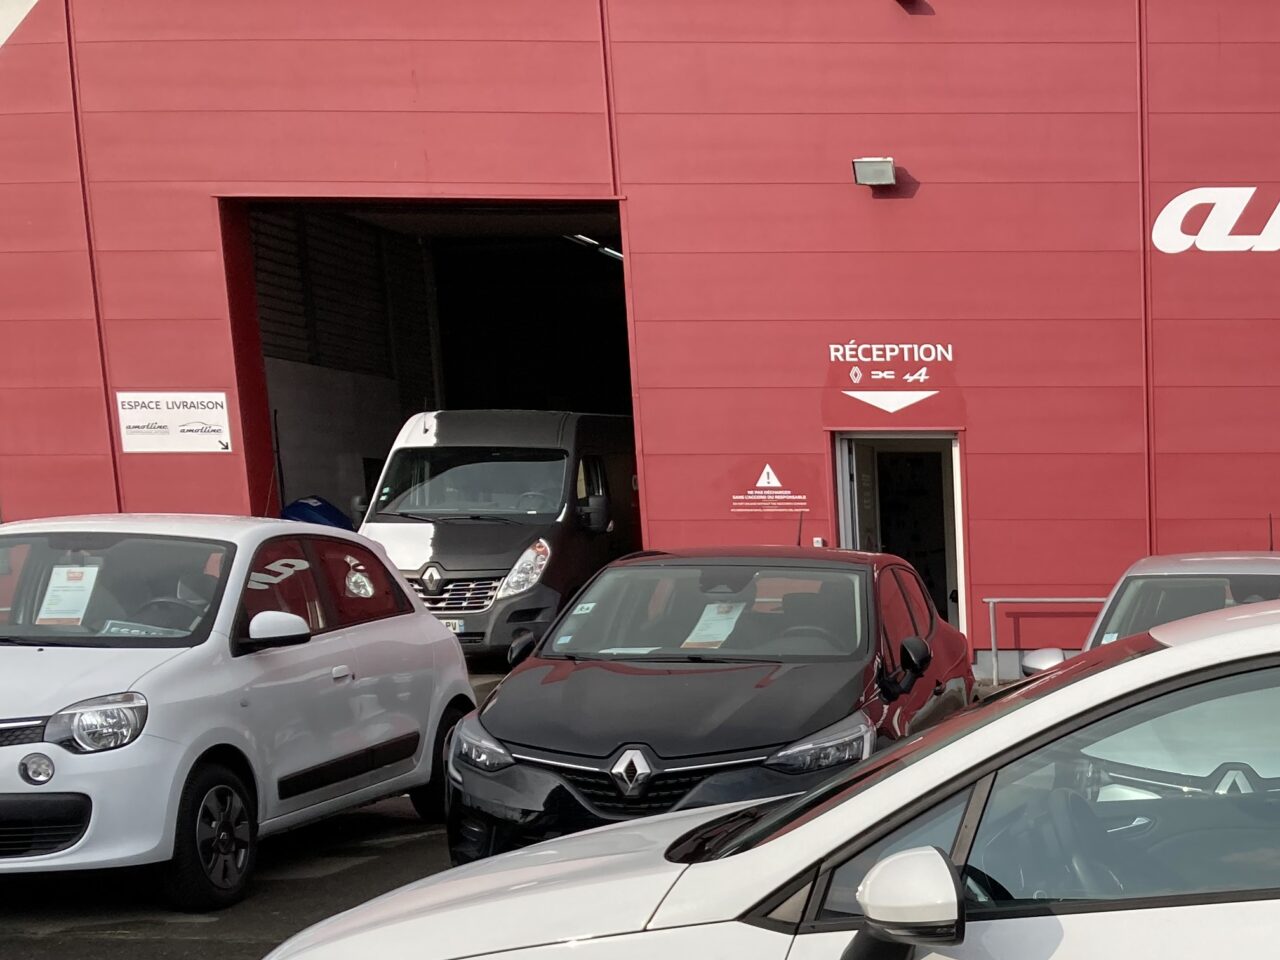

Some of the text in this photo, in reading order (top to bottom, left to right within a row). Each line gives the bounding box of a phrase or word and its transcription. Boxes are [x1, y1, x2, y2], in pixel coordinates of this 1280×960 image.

[828, 339, 953, 361] RÉCEPTION
[120, 400, 224, 410] ESPACE LIVRAISON
